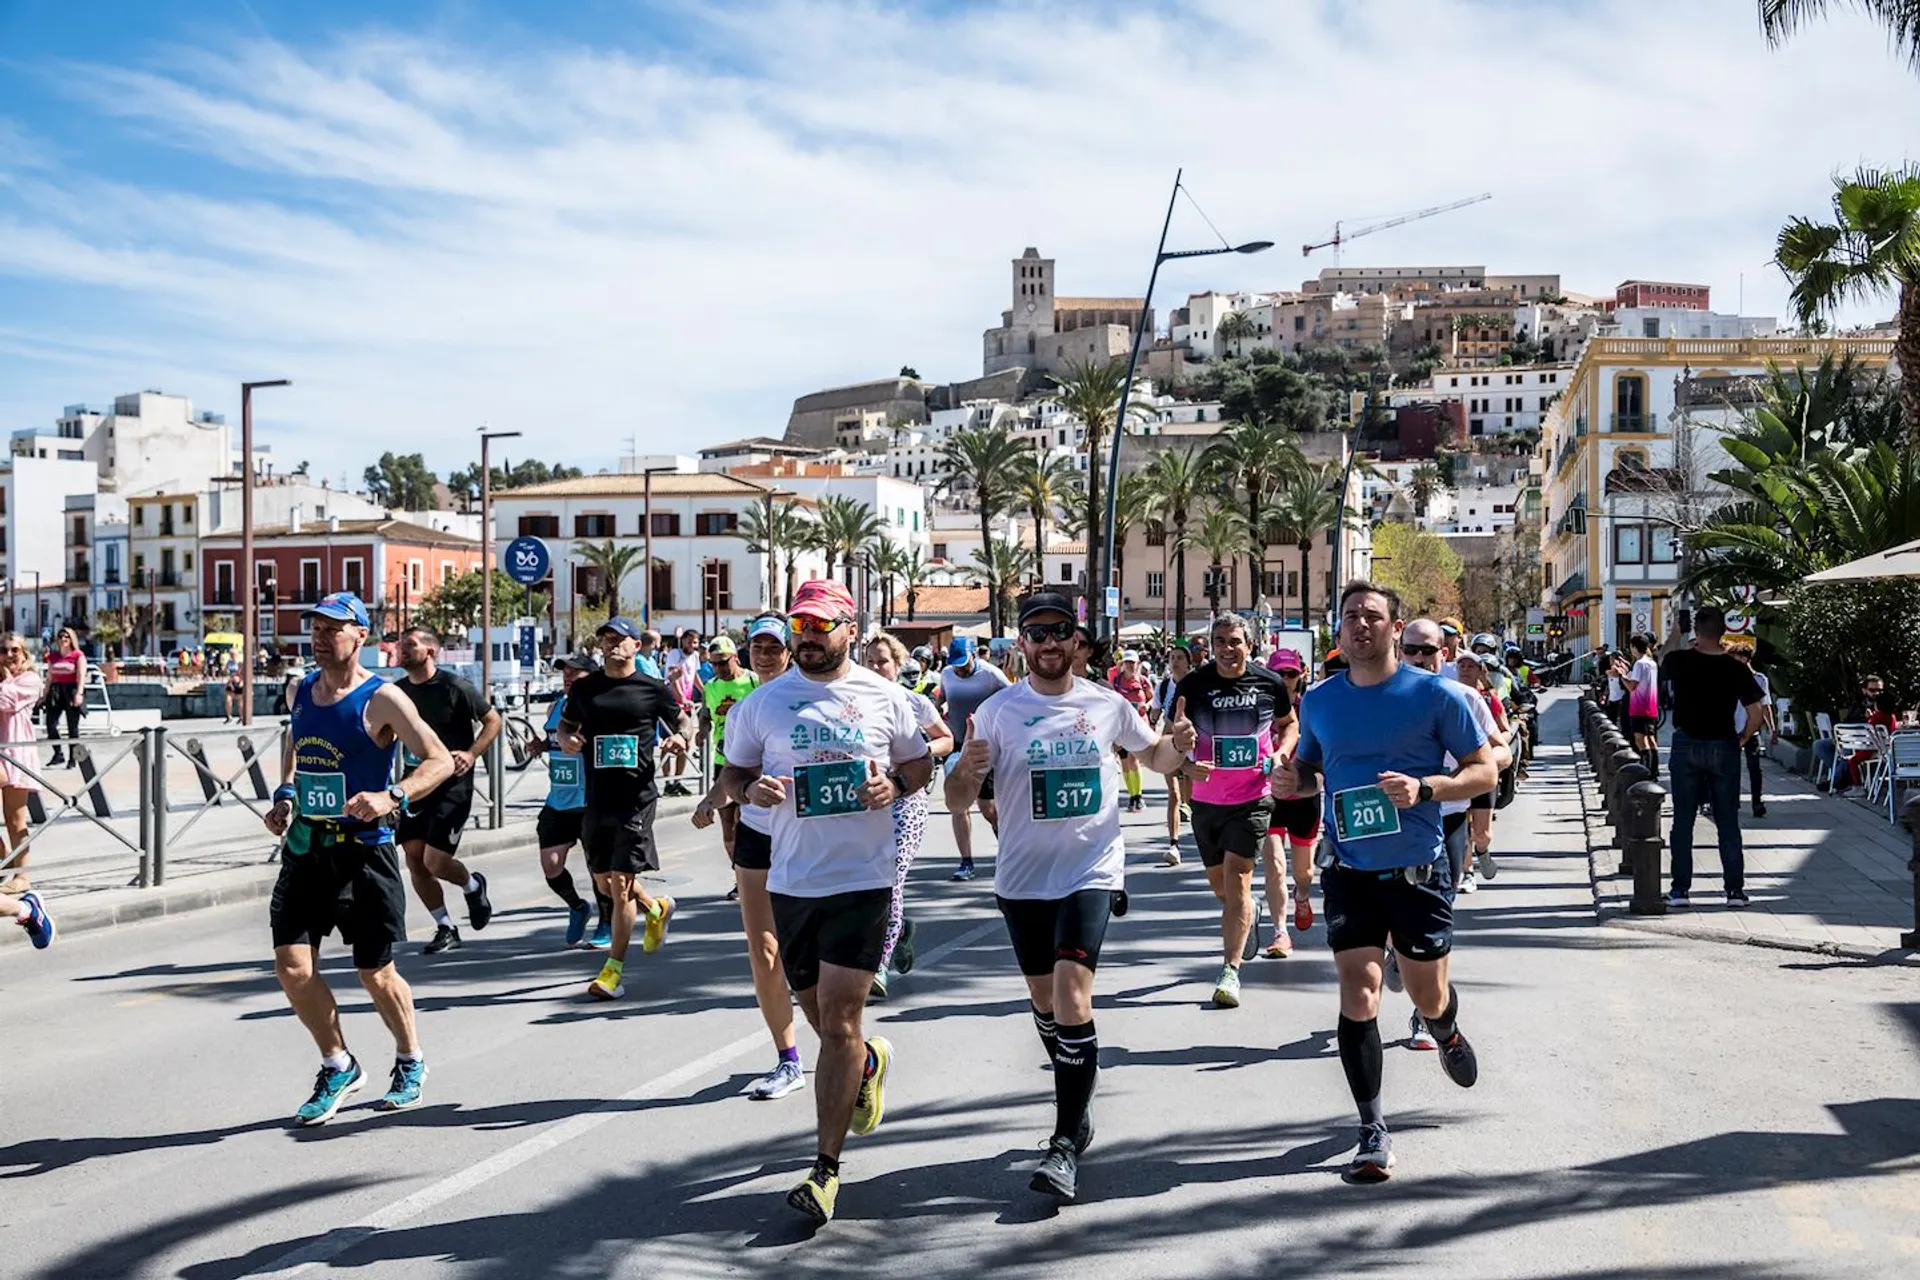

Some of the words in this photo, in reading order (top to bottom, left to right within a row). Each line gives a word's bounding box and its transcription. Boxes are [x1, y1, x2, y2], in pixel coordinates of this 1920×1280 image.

[814, 727, 865, 742] IBIZA
[608, 748, 632, 760] 343
[1050, 740, 1099, 756] IBIZA
[1228, 749, 1252, 762] 314
[554, 769, 573, 780] 715
[307, 791, 336, 808] 510
[820, 782, 858, 804] 316
[1056, 788, 1093, 808] 317
[1352, 805, 1385, 827] 201
